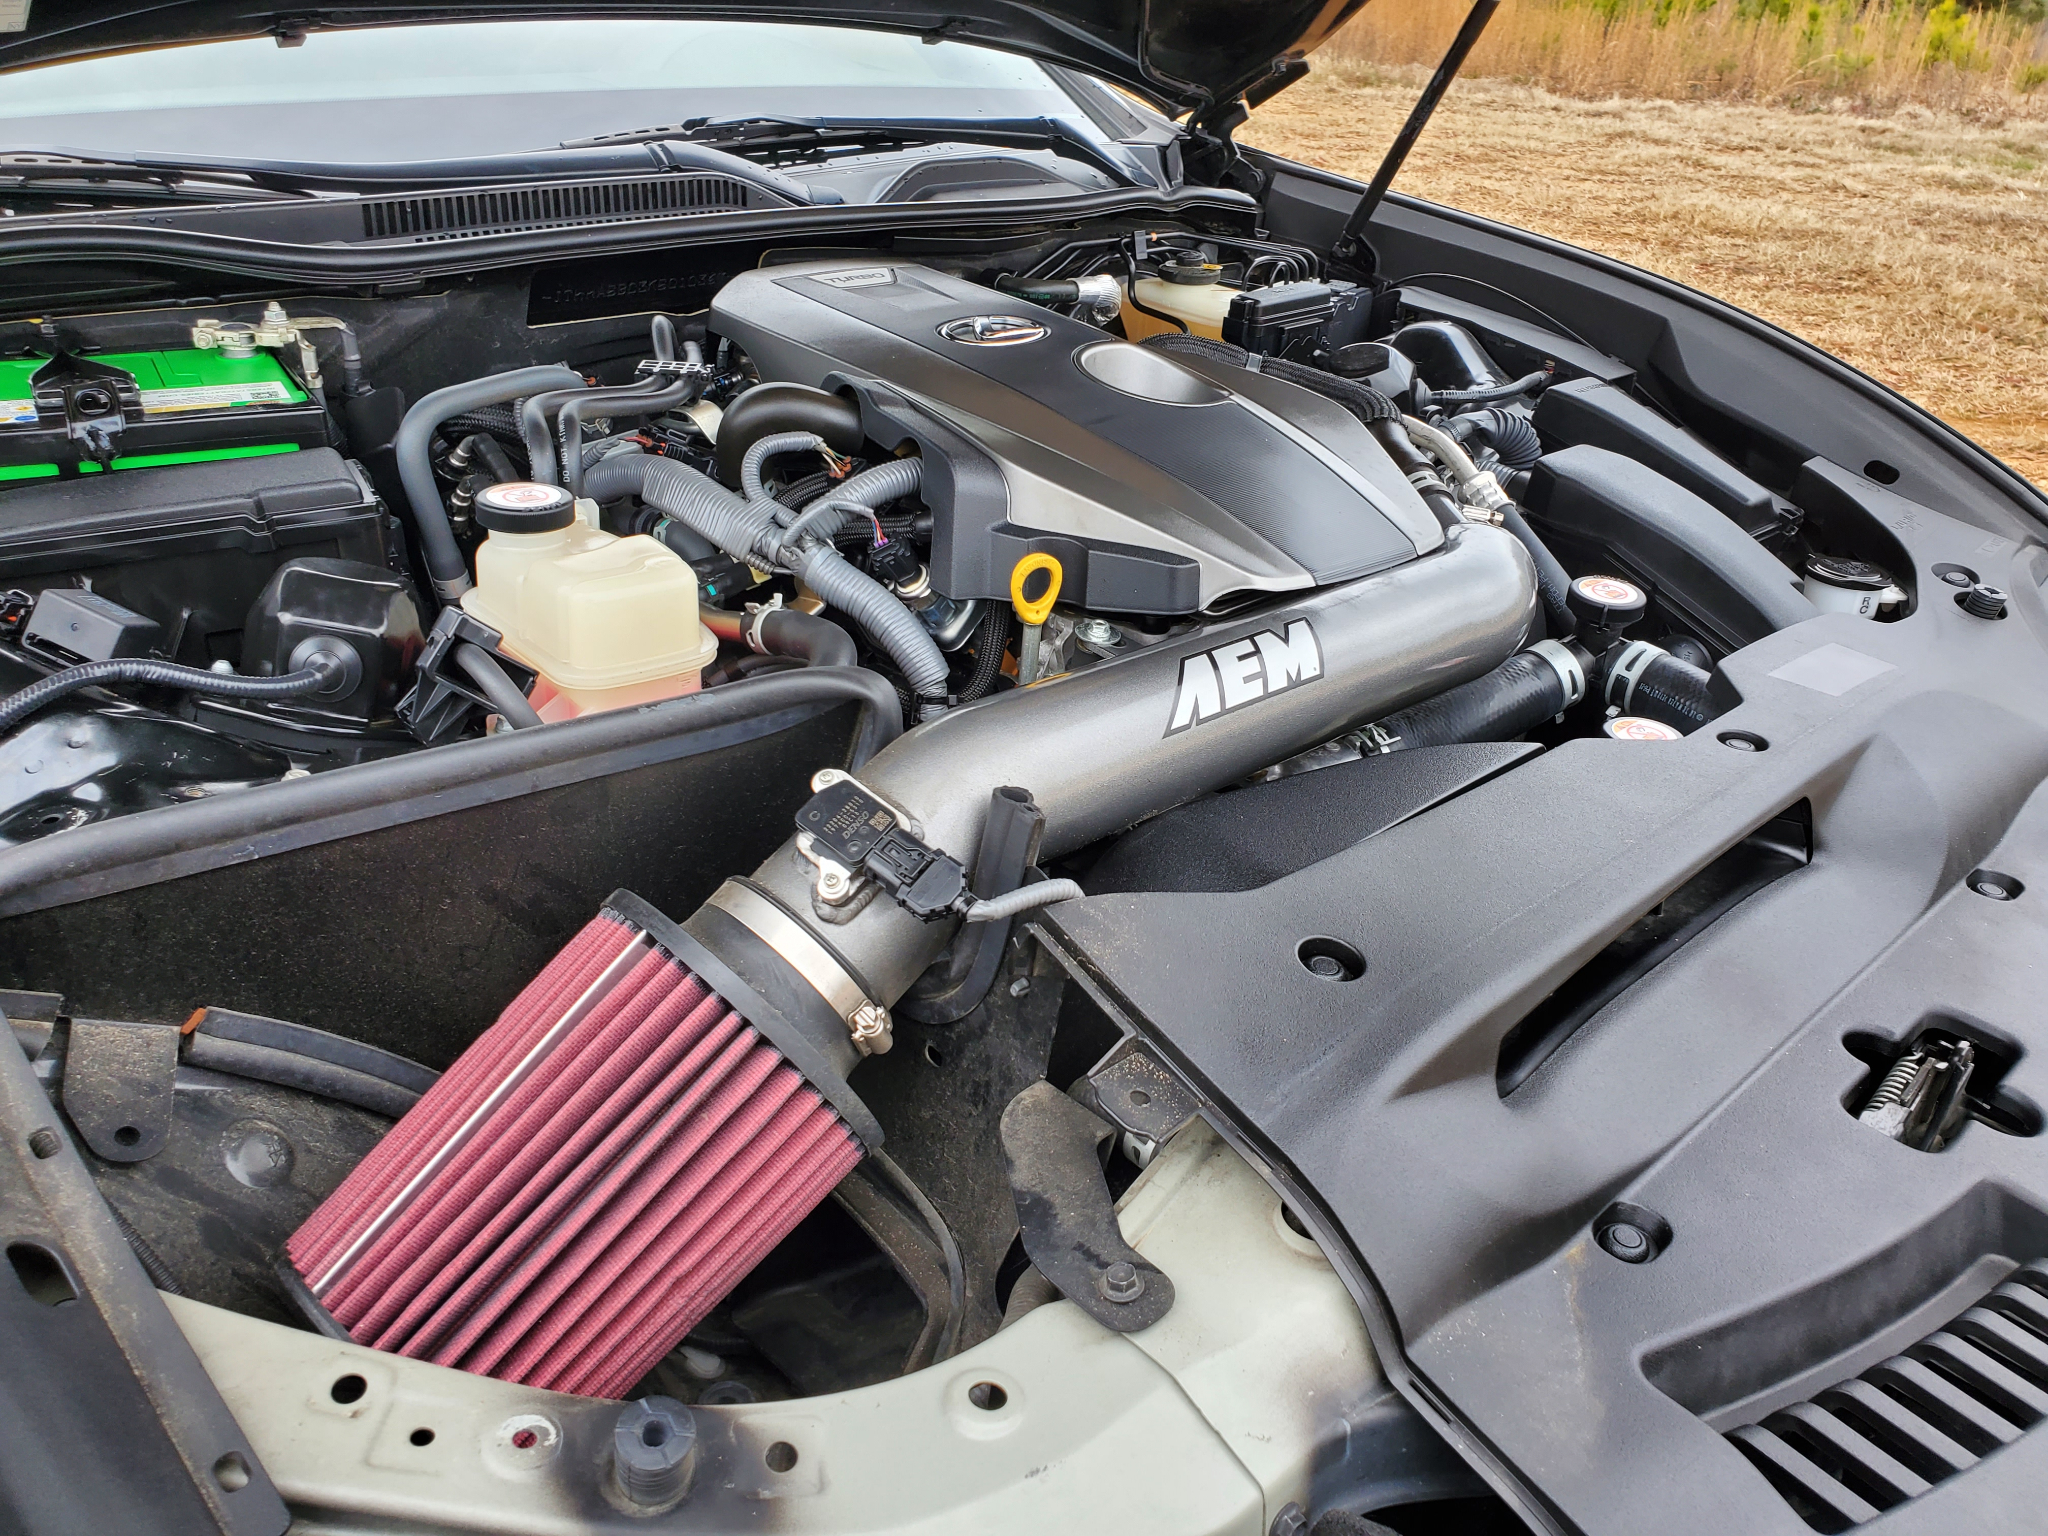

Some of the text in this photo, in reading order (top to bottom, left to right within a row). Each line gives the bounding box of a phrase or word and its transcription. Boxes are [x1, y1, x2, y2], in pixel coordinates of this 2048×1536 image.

[823, 272, 886, 283] TURBO
[561, 448, 569, 465] NOT
[562, 470, 570, 483] DO
[1163, 617, 1325, 739] AEM
[842, 810, 869, 839] DENSO
